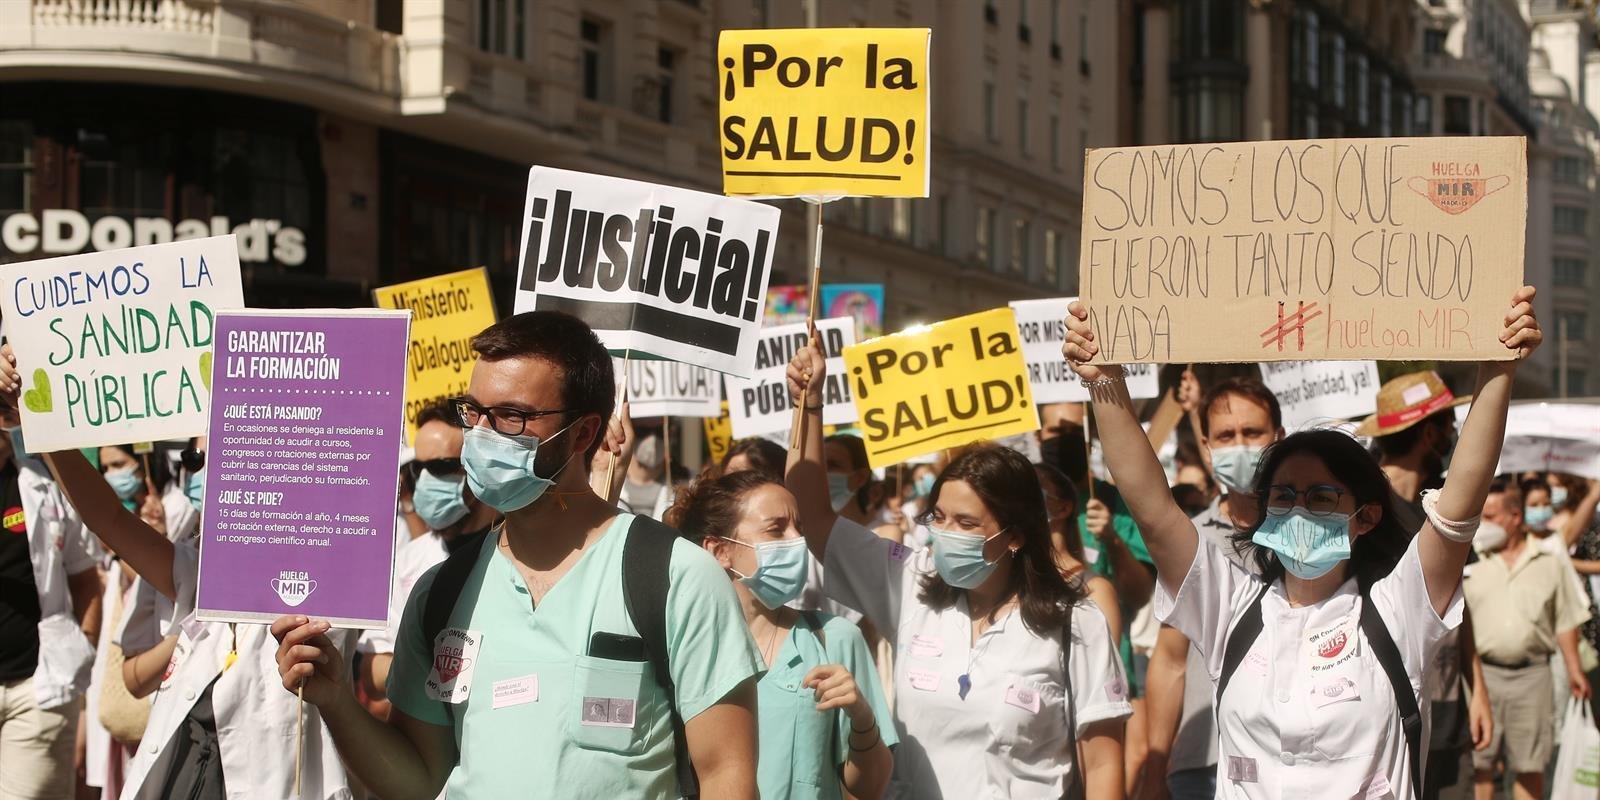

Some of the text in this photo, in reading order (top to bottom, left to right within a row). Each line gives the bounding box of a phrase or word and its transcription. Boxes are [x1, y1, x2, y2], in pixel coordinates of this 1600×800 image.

[723, 43, 918, 101] ¡Por la
[723, 115, 916, 166] SALUD!
[1432, 161, 1480, 176] HUELGA
[1093, 144, 1410, 231] SOMOS LOS QUE
[1437, 182, 1474, 196] MIR
[519, 189, 771, 322] ¡Justicia!
[1090, 235, 1210, 299] FUERON
[1223, 231, 1335, 298] TANTO
[15, 254, 213, 317] CUIDEMOS LA
[48, 300, 213, 366] SANIDAD
[228, 330, 326, 354] GARANTIZAR
[1090, 304, 1170, 361] NADA
[226, 353, 340, 380] LA FORMACIÓN
[853, 326, 1018, 399] ¡Por la
[629, 359, 714, 398] USTICIA!
[1351, 365, 1372, 396] ya!
[64, 365, 202, 428] PÚBLICA
[864, 374, 1028, 442] SALUD!
[224, 403, 322, 420] ¿QUÉ ESTÁ PASANDO?
[224, 423, 384, 437] En ocasiones se deniega al residente la
[223, 436, 352, 449] oportunidad de acudir a cursos,
[222, 449, 264, 461] congresos
[274, 450, 317, 460] rotaciones
[319, 452, 354, 461] externas
[356, 452, 371, 462] por
[222, 460, 349, 473] cubrir las carencias del sistema
[220, 473, 370, 486] sanitario, perjudicando su formación.
[218, 489, 284, 506] ¿QUÉ SE PIDE?
[220, 509, 370, 524] 15 días de formación al año, 4 meses
[217, 522, 228, 530] de
[230, 522, 263, 532] rotación
[264, 524, 298, 534] externa,
[300, 524, 334, 534] derecho
[342, 526, 369, 536] acudir
[228, 535, 267, 546] congreso
[268, 536, 306, 546] científico
[308, 538, 332, 547] anual.
[280, 570, 309, 580] HUELGA
[281, 582, 306, 596] MIR
